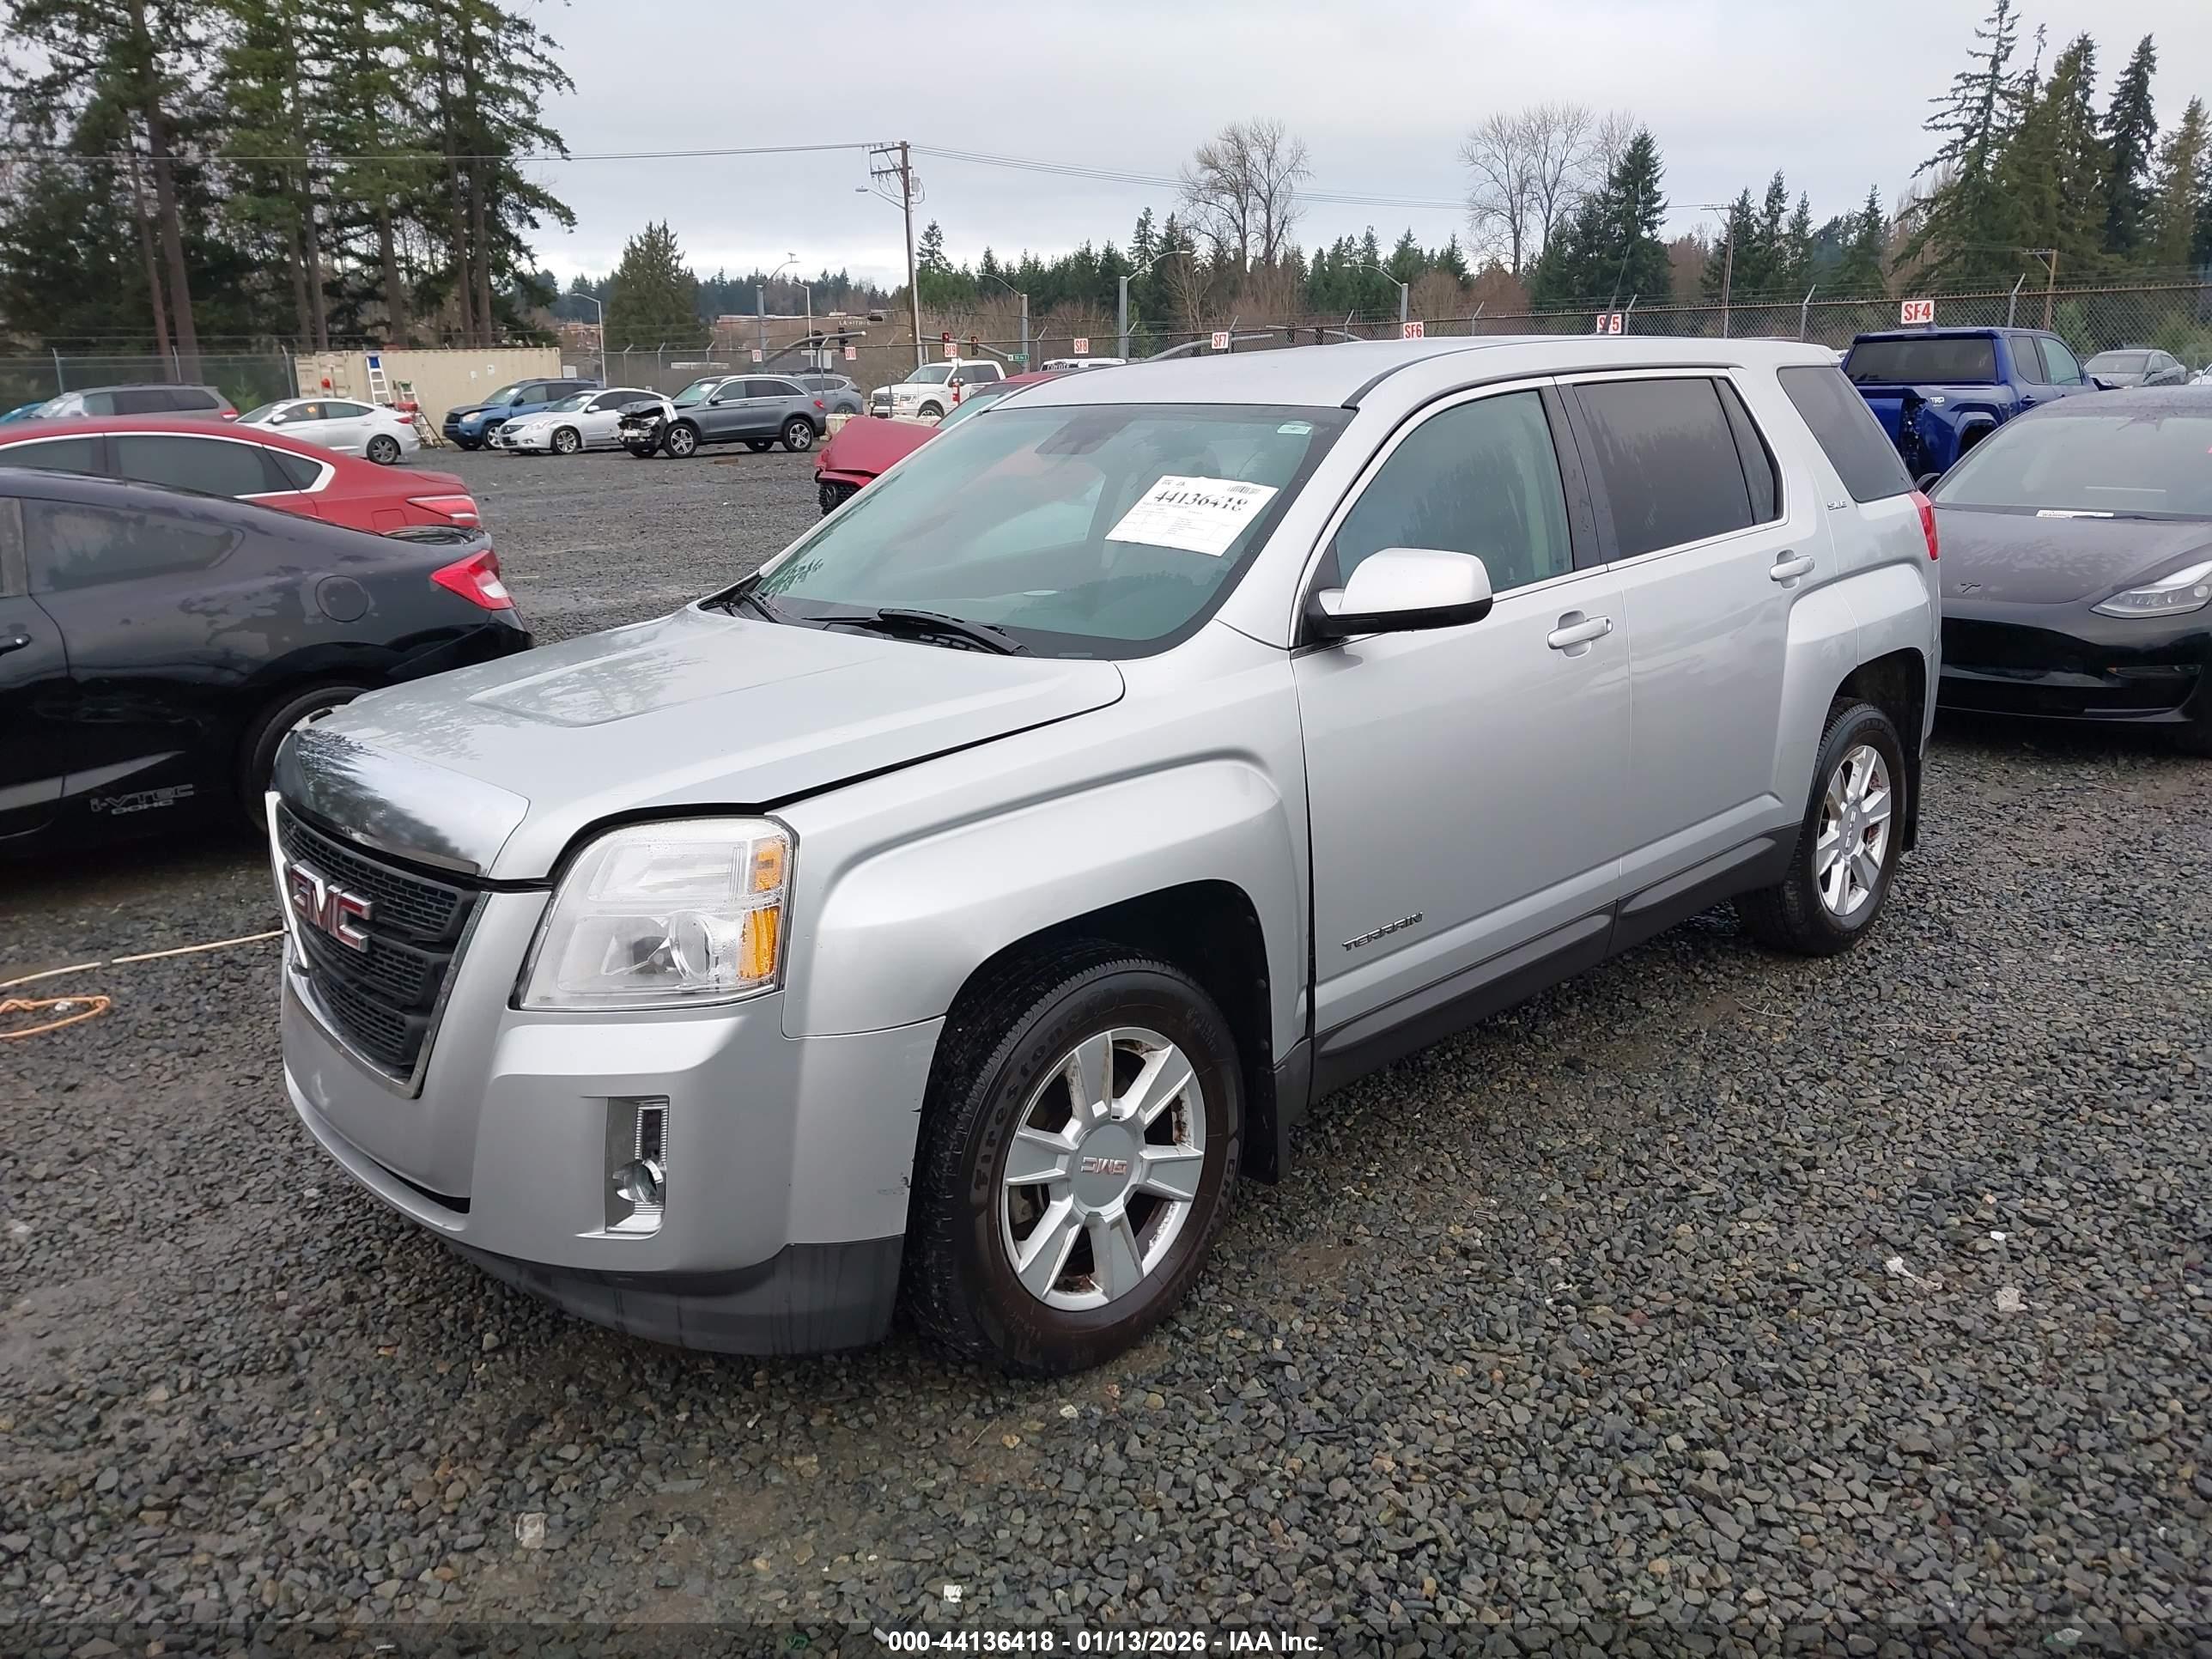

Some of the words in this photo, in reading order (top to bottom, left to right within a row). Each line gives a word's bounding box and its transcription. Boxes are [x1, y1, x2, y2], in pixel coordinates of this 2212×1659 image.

[1904, 302, 1931, 321] SF4
[1599, 316, 1619, 331] S5
[1405, 324, 1422, 338] SF6
[1075, 339, 1087, 352] SF8
[1213, 334, 1226, 347] SF7
[945, 345, 956, 356] SF9
[1826, 501, 1848, 511] SLE
[289, 863, 373, 953] GMC
[1341, 911, 1423, 951] TERRAIN
[1080, 1156, 1127, 1176] GMC
